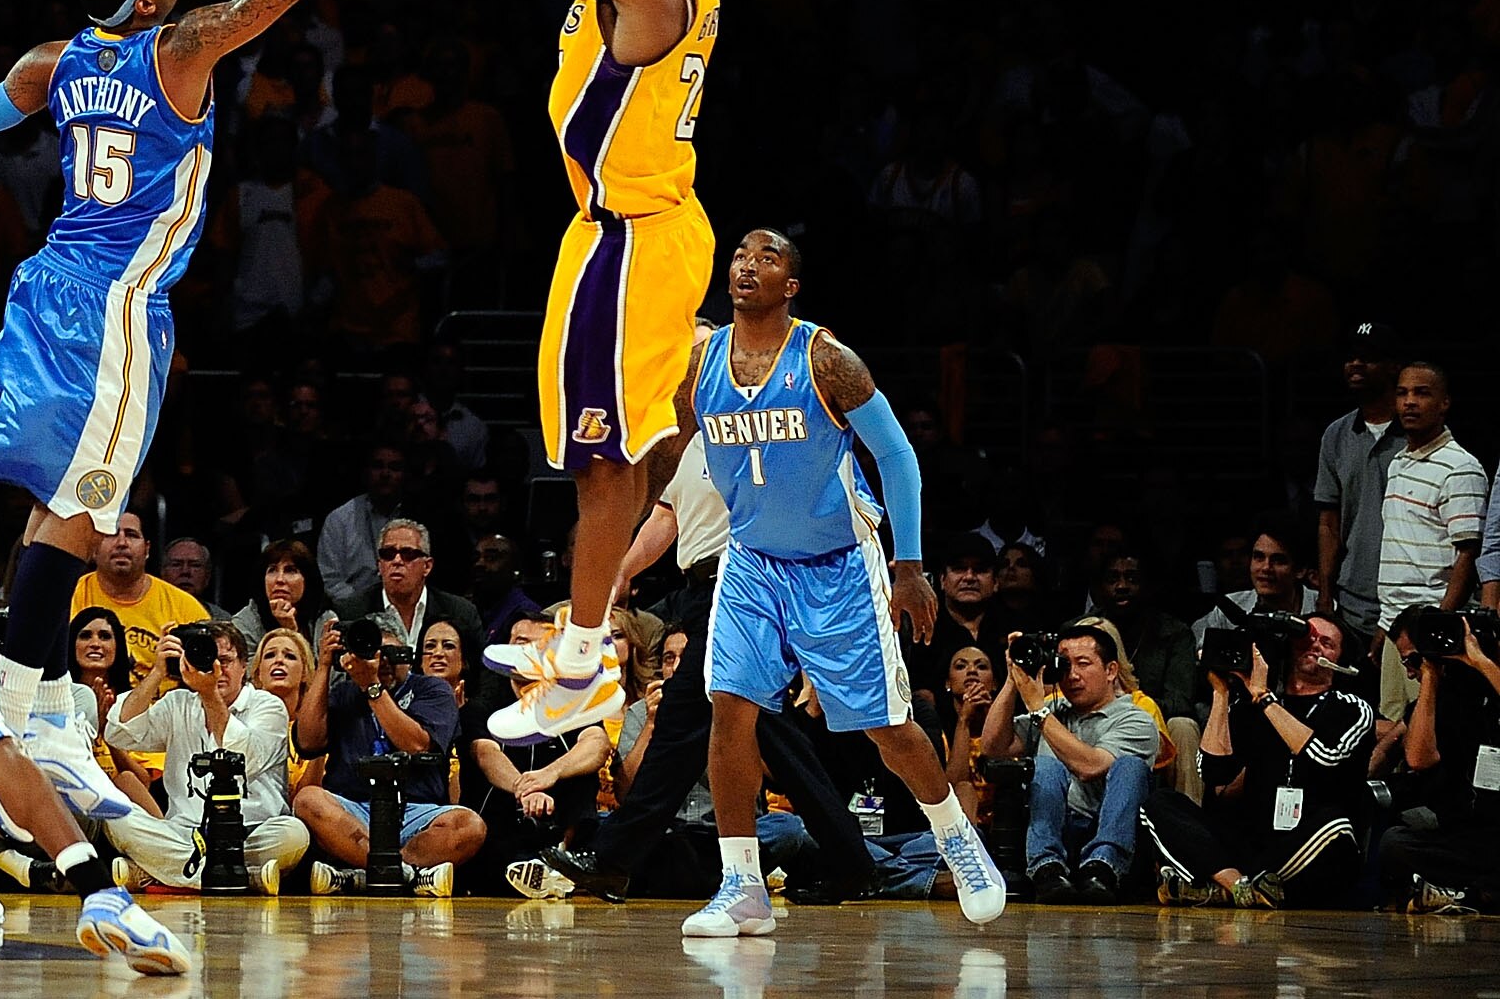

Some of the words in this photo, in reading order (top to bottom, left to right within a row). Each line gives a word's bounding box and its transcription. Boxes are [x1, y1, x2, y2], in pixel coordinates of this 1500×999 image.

[57, 76, 157, 128] ANTHONY
[70, 123, 136, 207] 15
[701, 407, 808, 446] DENVER
[749, 447, 766, 487] 1
